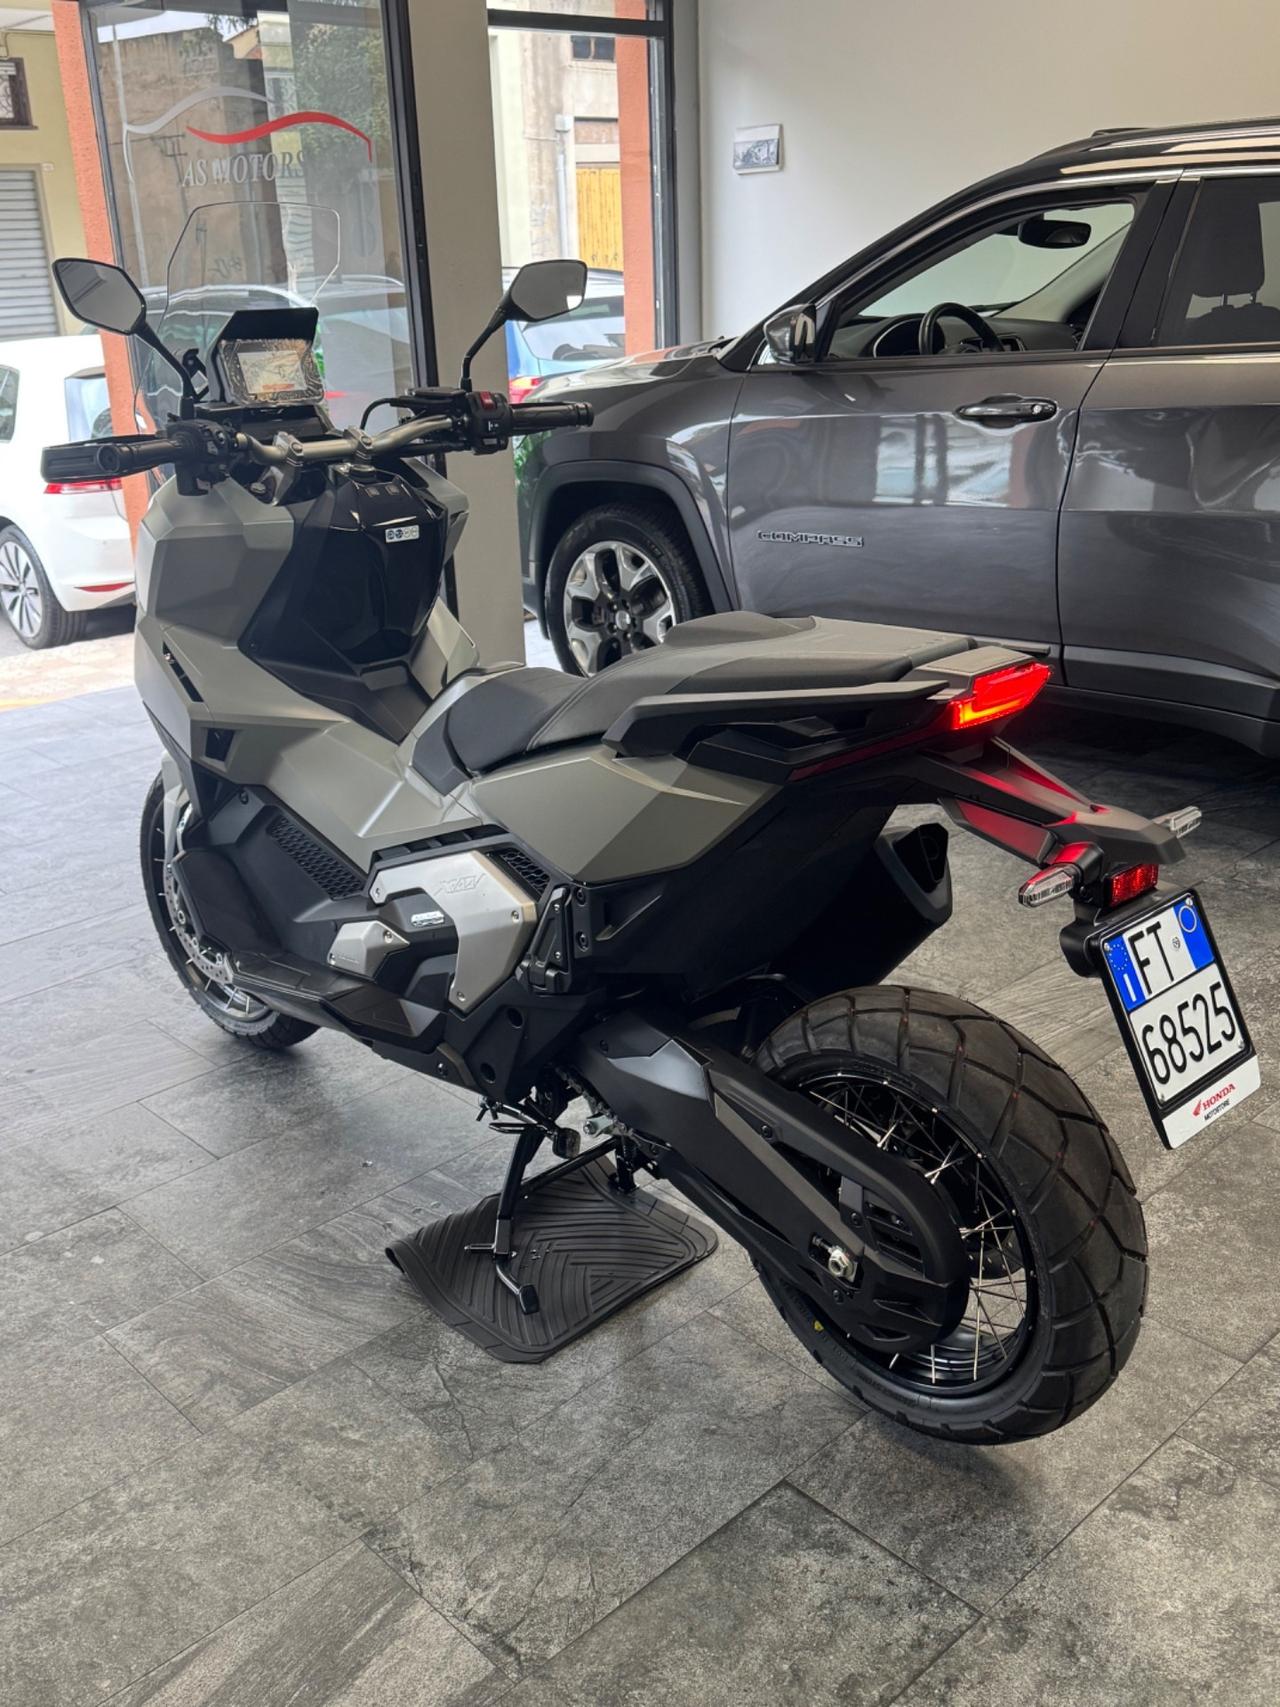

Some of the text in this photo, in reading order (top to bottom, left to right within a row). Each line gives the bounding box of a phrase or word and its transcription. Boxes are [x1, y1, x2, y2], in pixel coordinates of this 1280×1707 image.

[182, 151, 305, 187] AS MOTORS
[757, 530, 865, 548] COMPASS
[1128, 921, 1174, 995] FT
[1142, 981, 1236, 1085] 68525
[1202, 1083, 1236, 1110] HONDA
